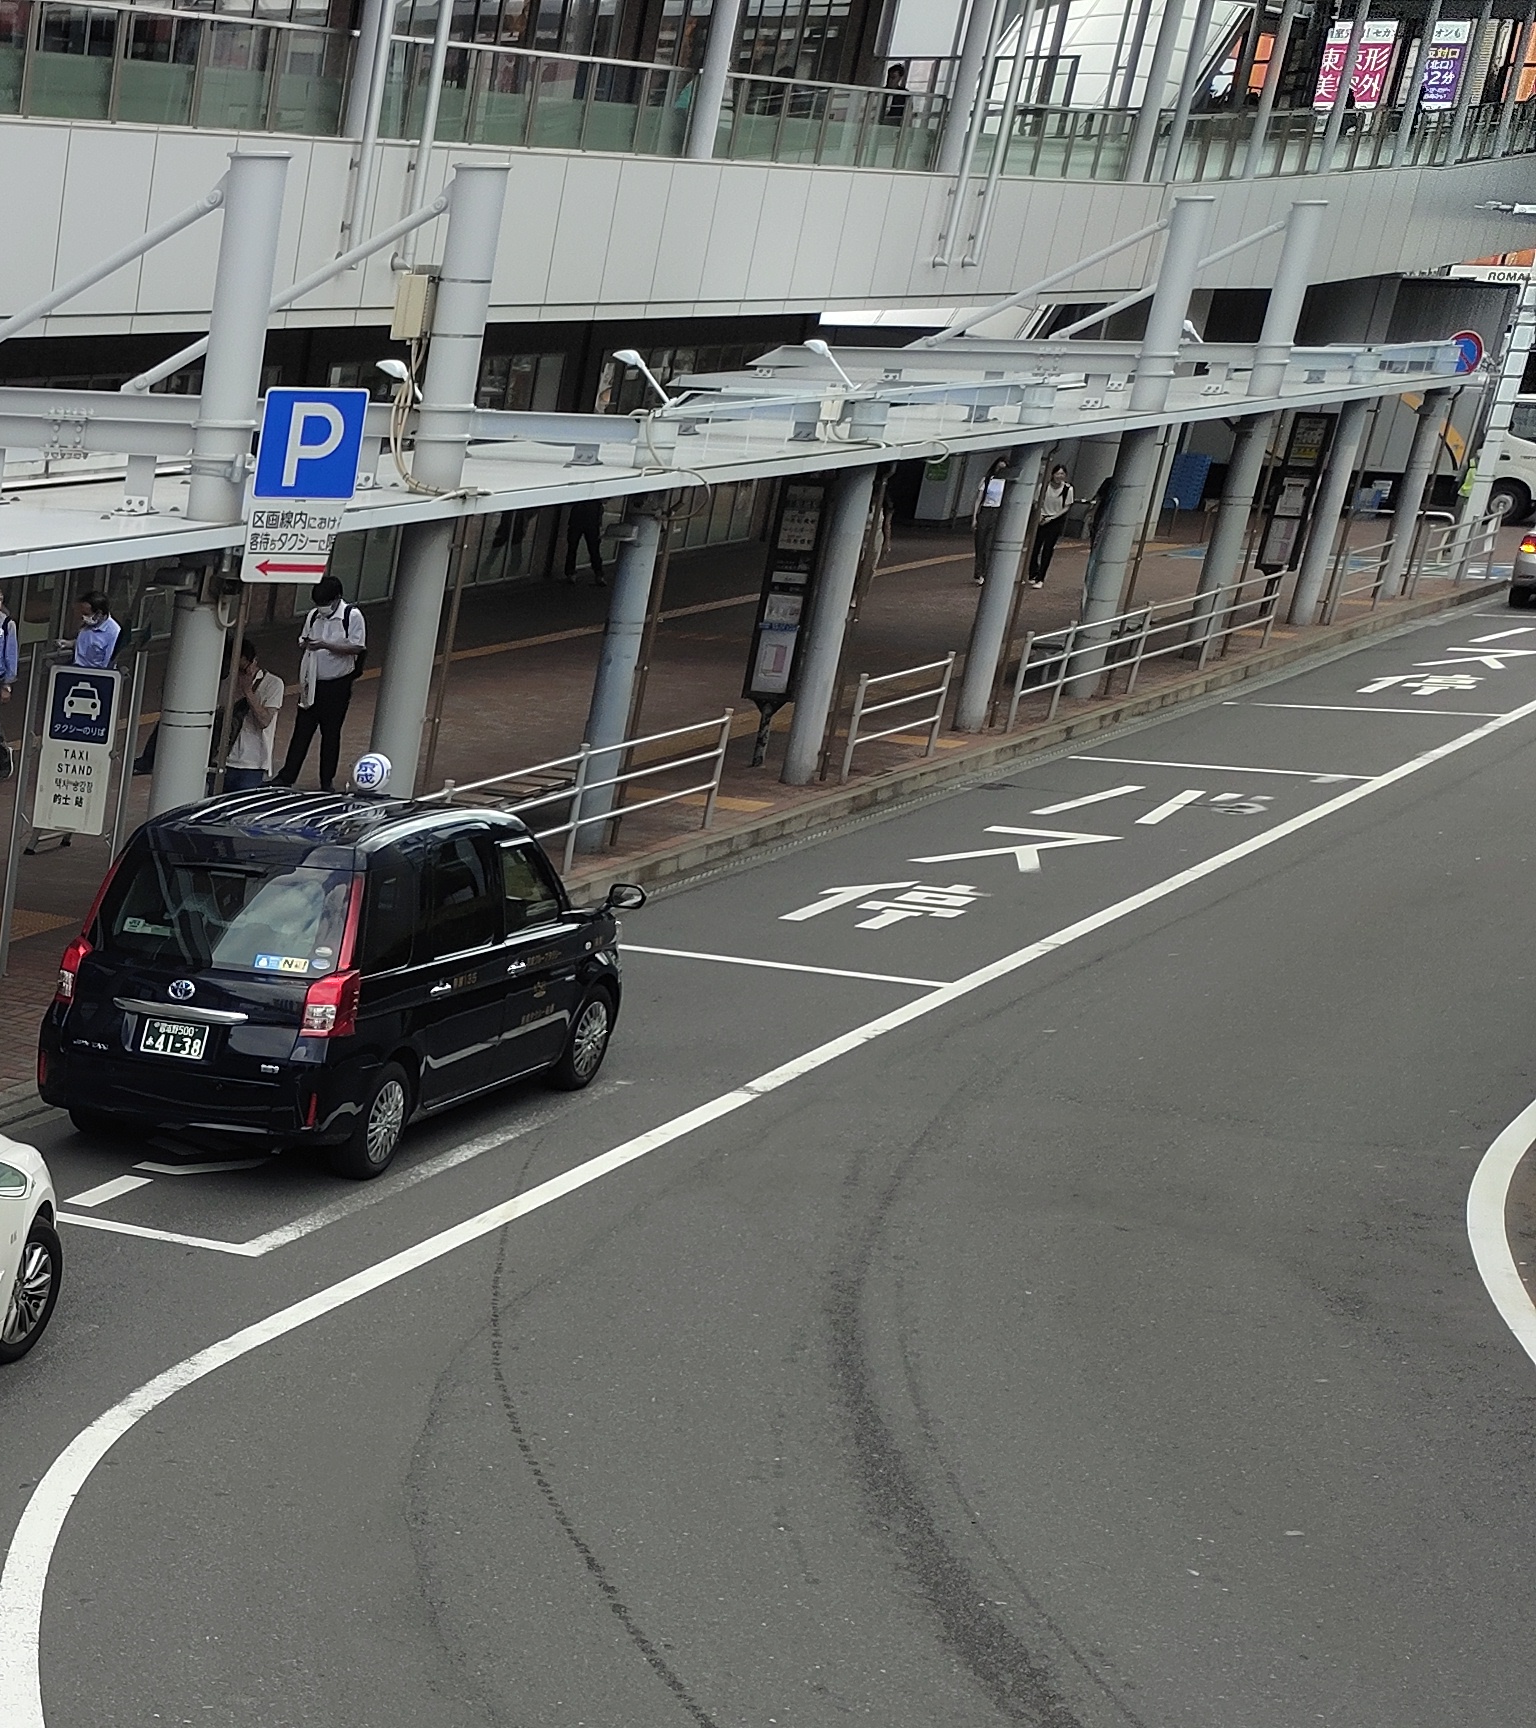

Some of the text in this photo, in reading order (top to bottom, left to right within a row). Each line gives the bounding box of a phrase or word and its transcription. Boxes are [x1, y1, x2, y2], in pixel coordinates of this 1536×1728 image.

[281, 401, 345, 487] P
[54, 723, 106, 737] タクシーのりば
[64, 748, 89, 761] TAXI
[57, 762, 93, 776] STAND
[155, 1034, 202, 1056] 41-38
